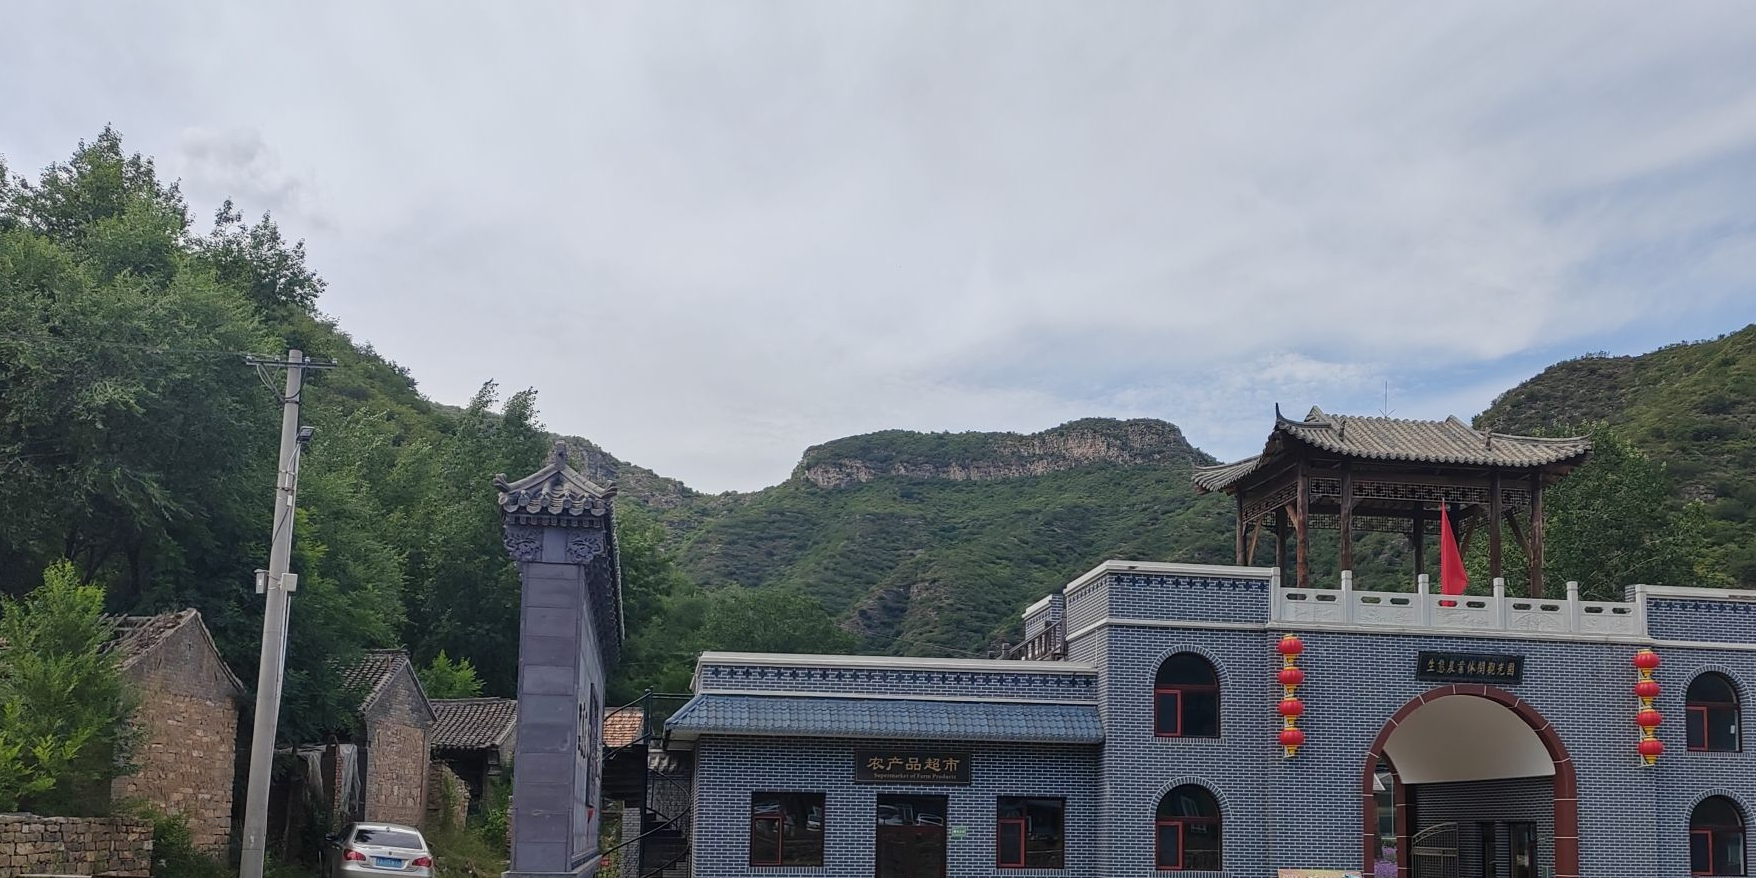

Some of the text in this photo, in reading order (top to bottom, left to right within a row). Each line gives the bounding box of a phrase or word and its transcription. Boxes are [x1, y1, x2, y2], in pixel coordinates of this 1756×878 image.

[867, 757, 960, 771] 农产品超市
